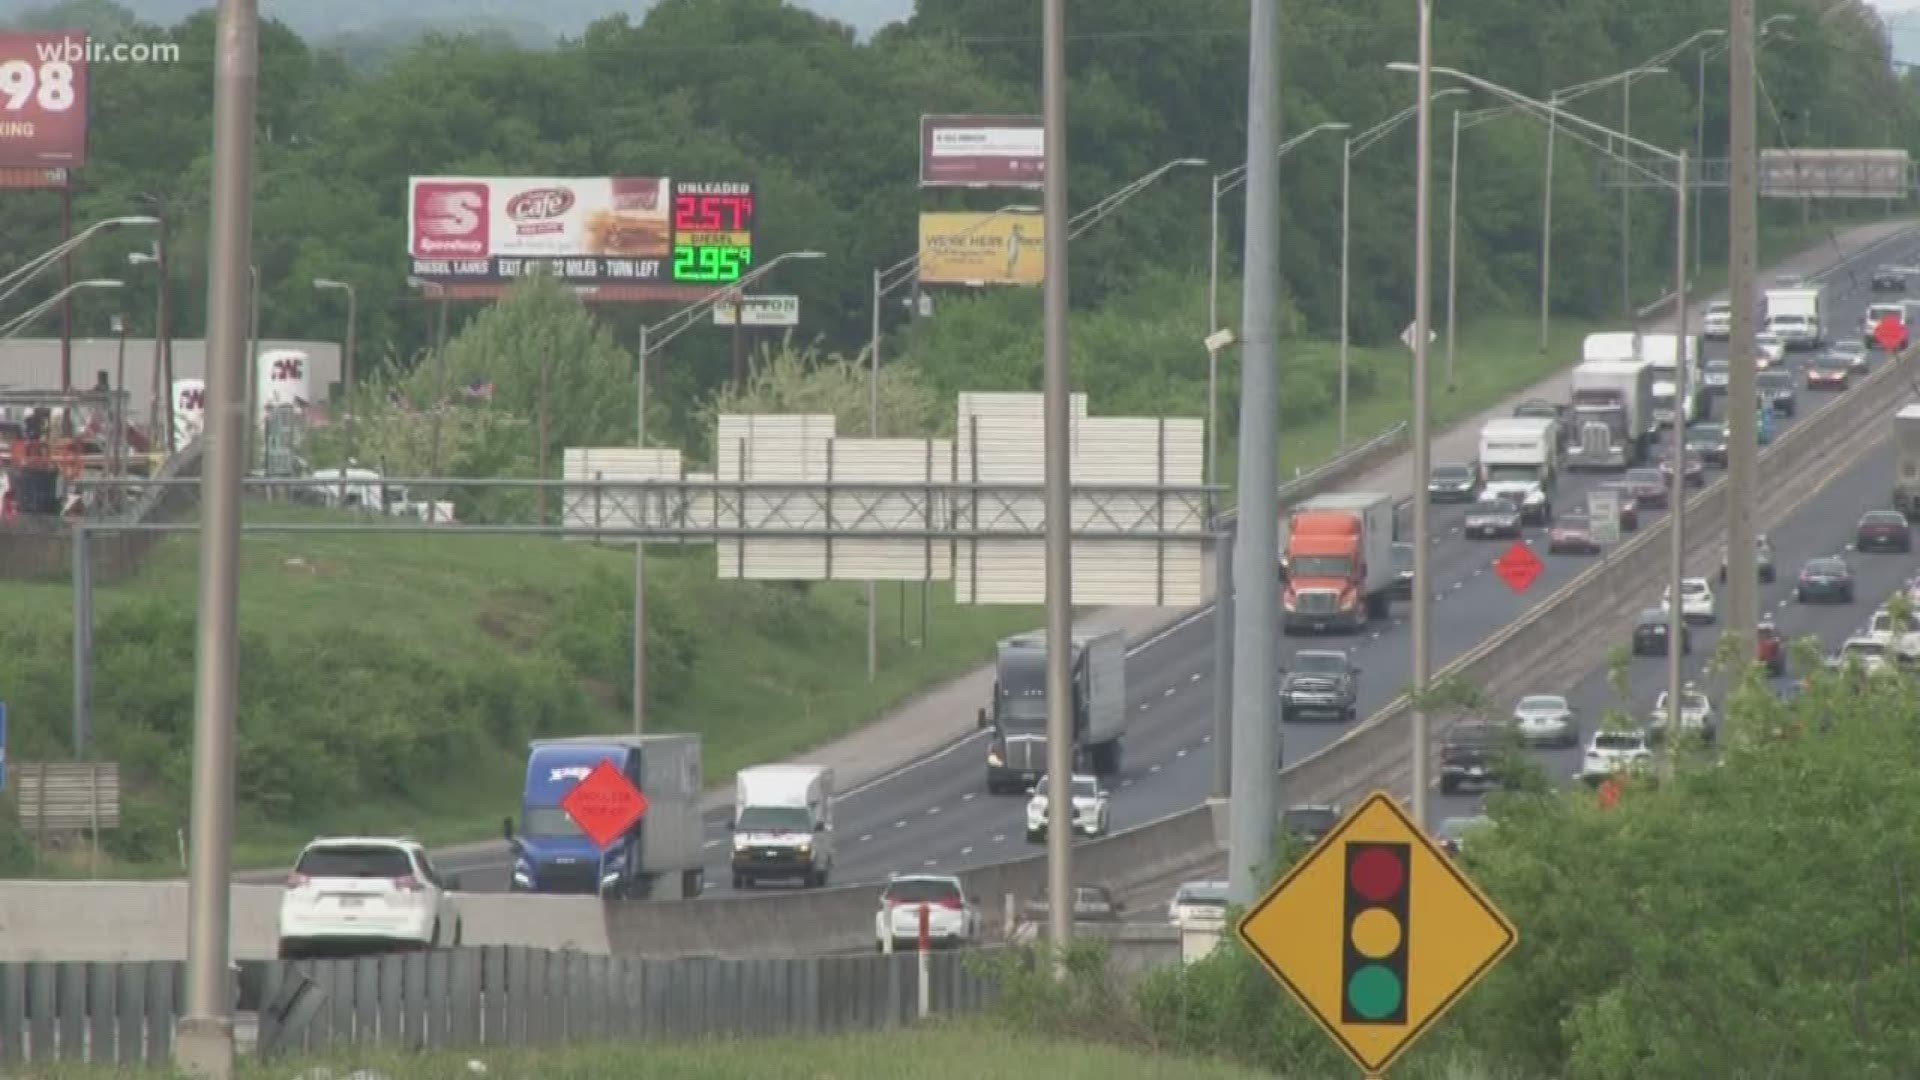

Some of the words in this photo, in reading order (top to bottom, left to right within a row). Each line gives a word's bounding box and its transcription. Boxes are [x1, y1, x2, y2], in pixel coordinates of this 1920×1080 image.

[0, 60, 74, 111] 98
[677, 183, 750, 194] UNLEADED
[421, 238, 482, 252] Speedway
[635, 259, 660, 277] LEFT
